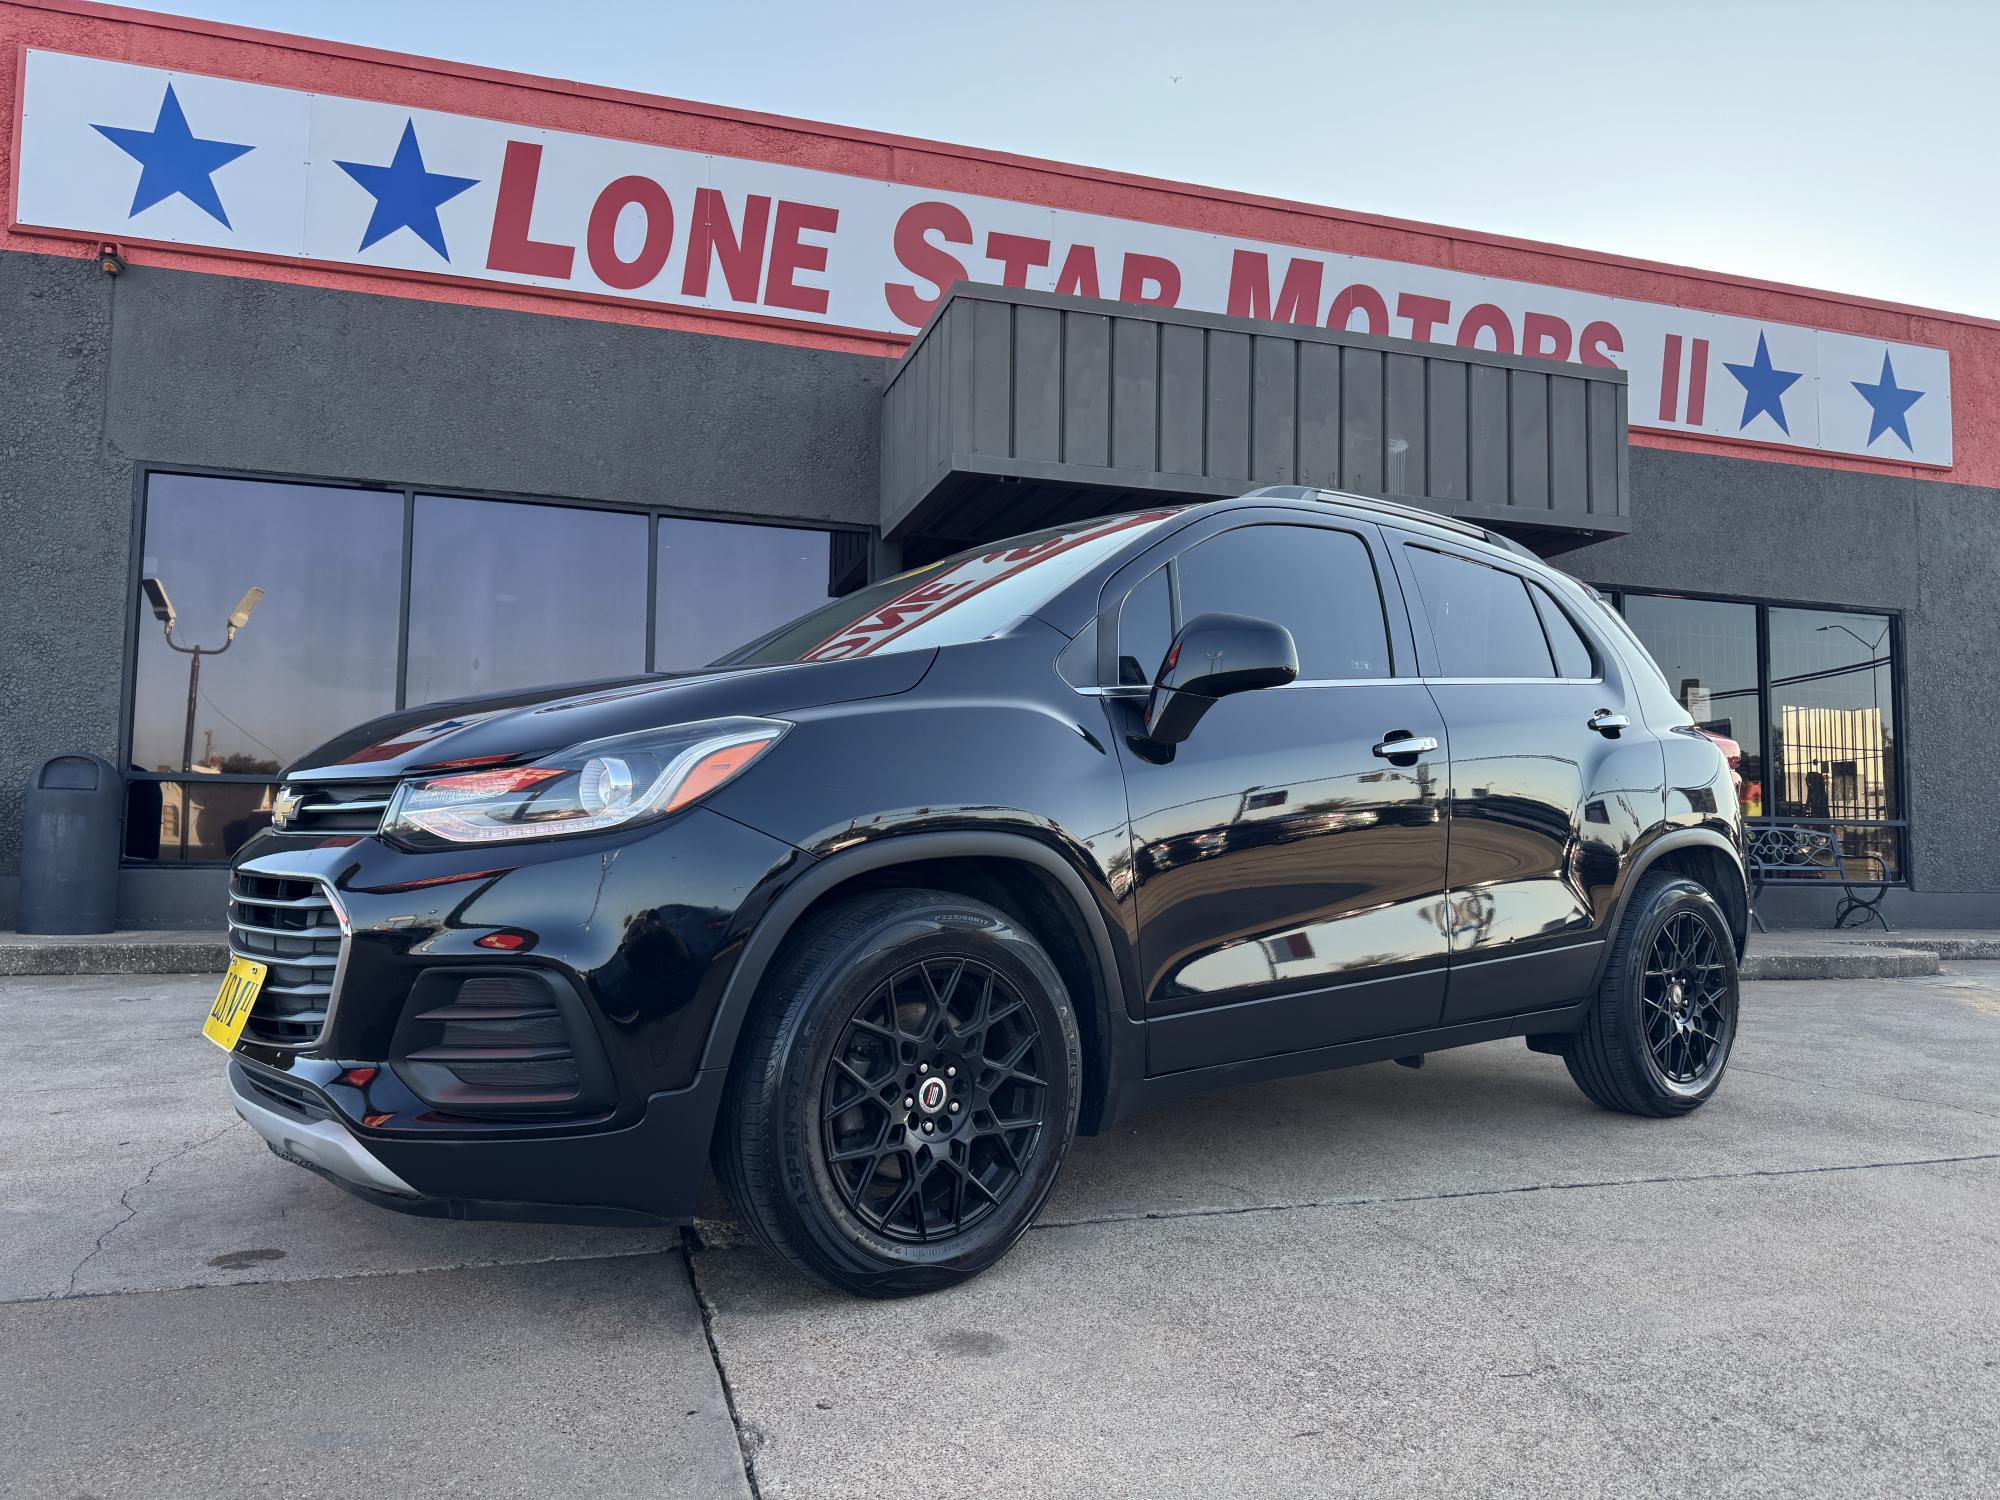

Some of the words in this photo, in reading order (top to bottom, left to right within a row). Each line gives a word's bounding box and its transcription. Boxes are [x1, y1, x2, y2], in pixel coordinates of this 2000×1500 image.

[486, 140, 839, 315] LONE
[1658, 333, 1710, 427] II
[785, 1074, 801, 1110] GT
[783, 1121, 811, 1206] ASPEN
